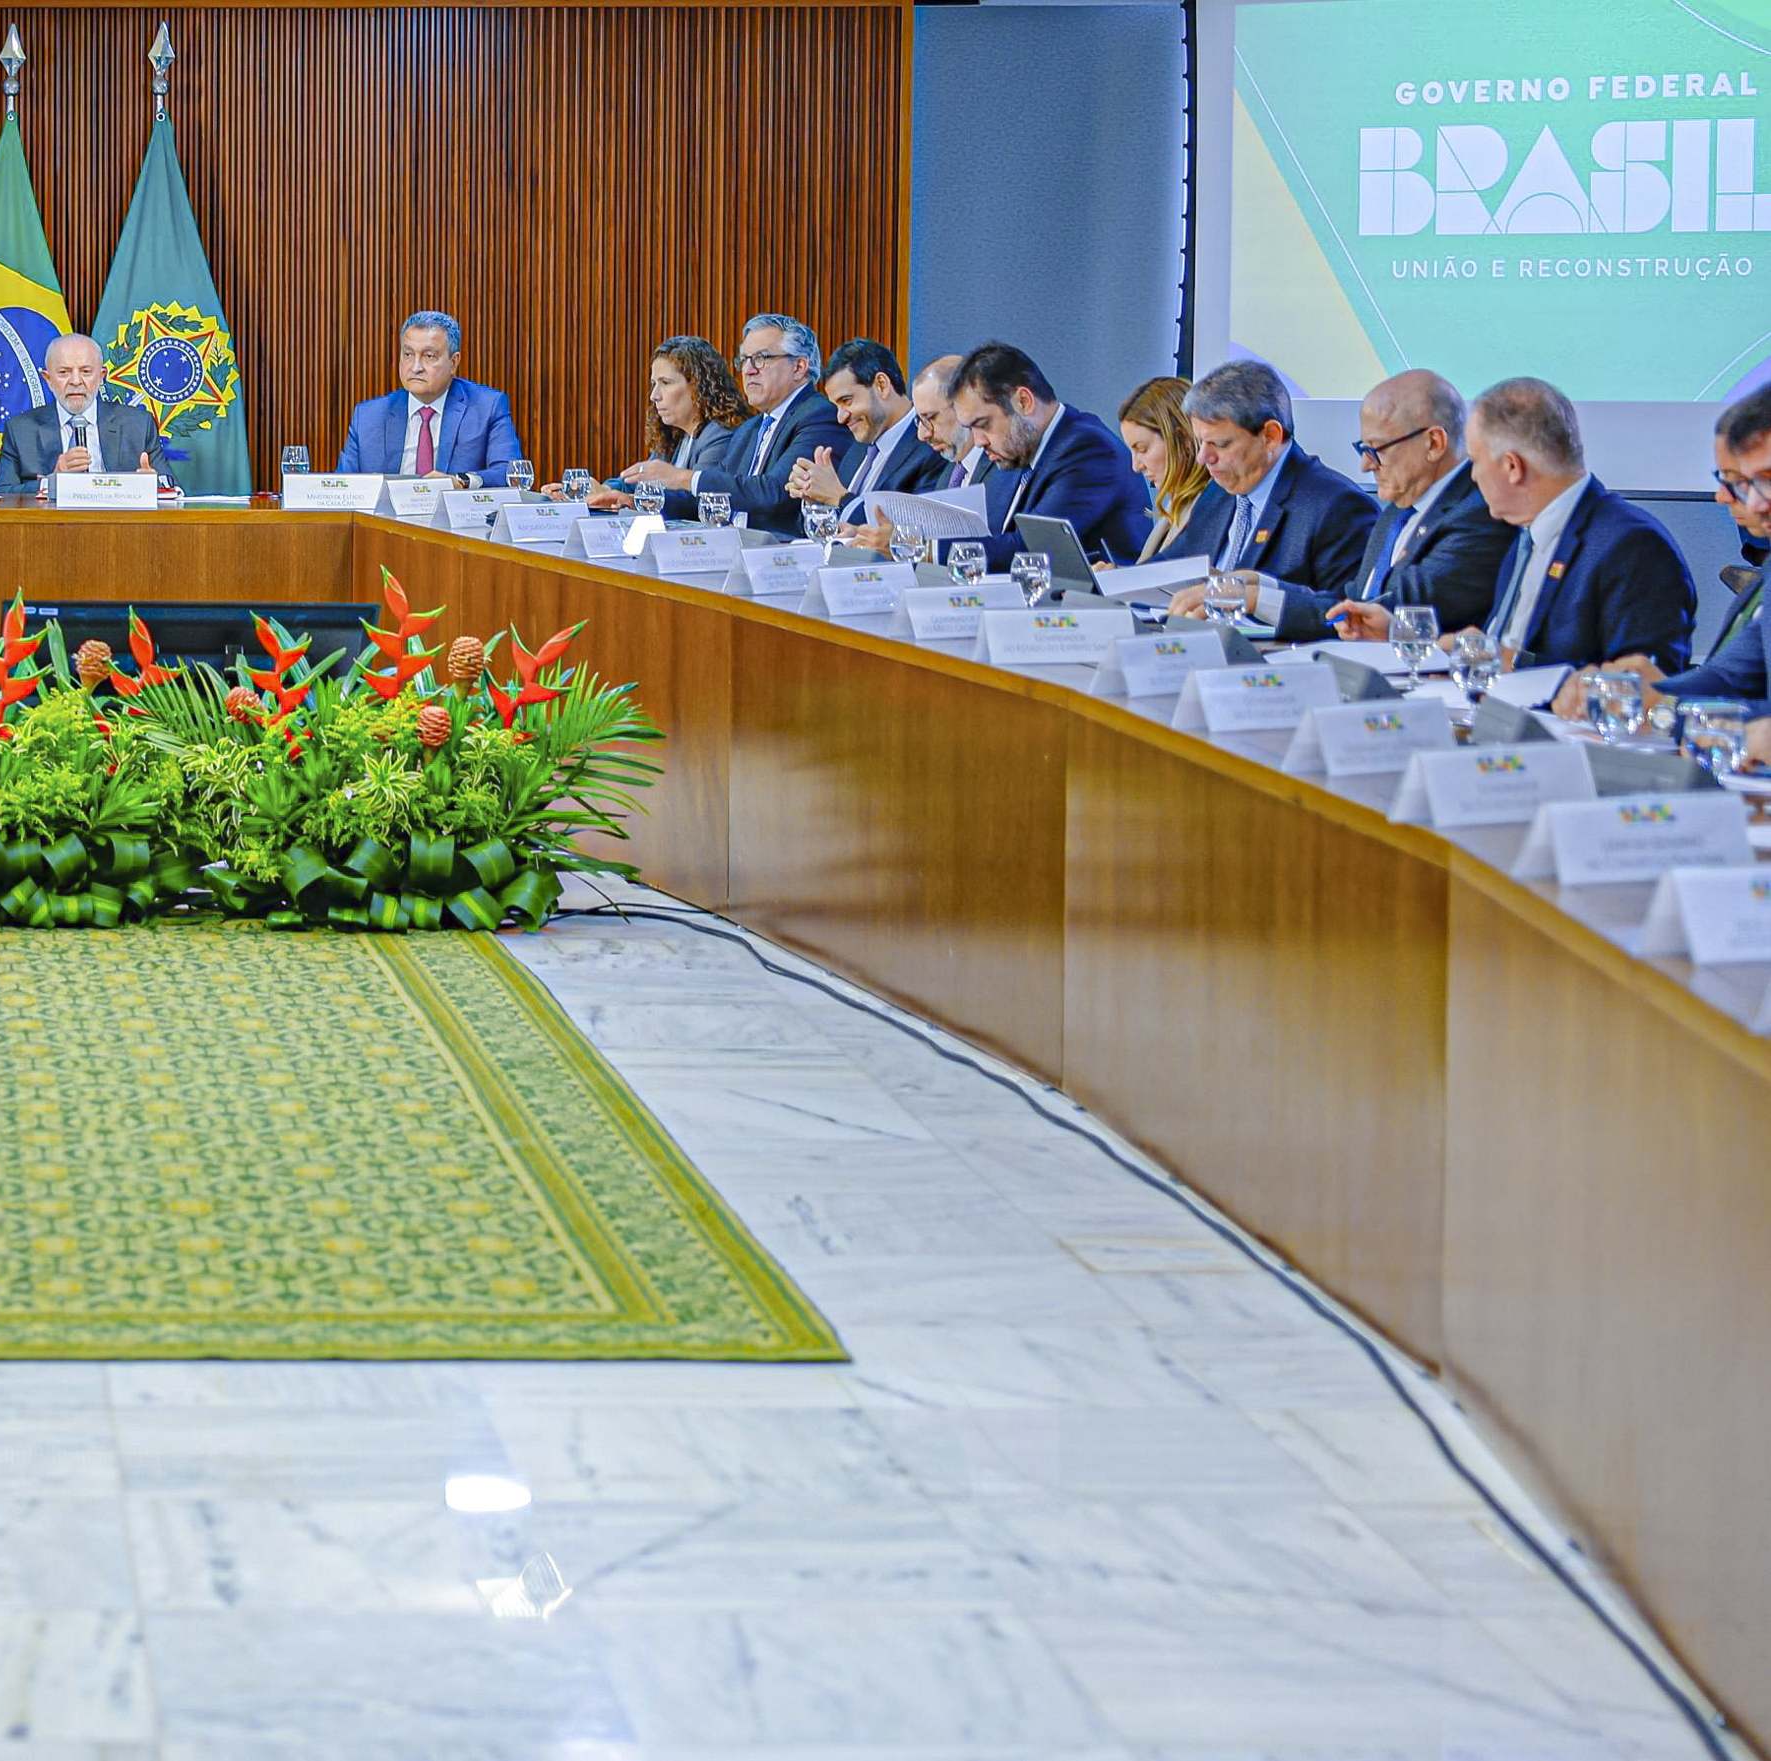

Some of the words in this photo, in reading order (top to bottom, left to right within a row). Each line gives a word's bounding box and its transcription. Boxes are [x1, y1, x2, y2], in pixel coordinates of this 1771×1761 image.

[1395, 77, 1571, 105] GOVERNO
[1589, 72, 1758, 100] FEDERAL
[1358, 118, 1771, 236] BRASIL
[1392, 256, 1478, 279] UNIÃO
[1491, 259, 1505, 278] E
[1519, 254, 1754, 281] RECONSTRUÇÃO
[23, 357, 45, 407] PROGRESS
